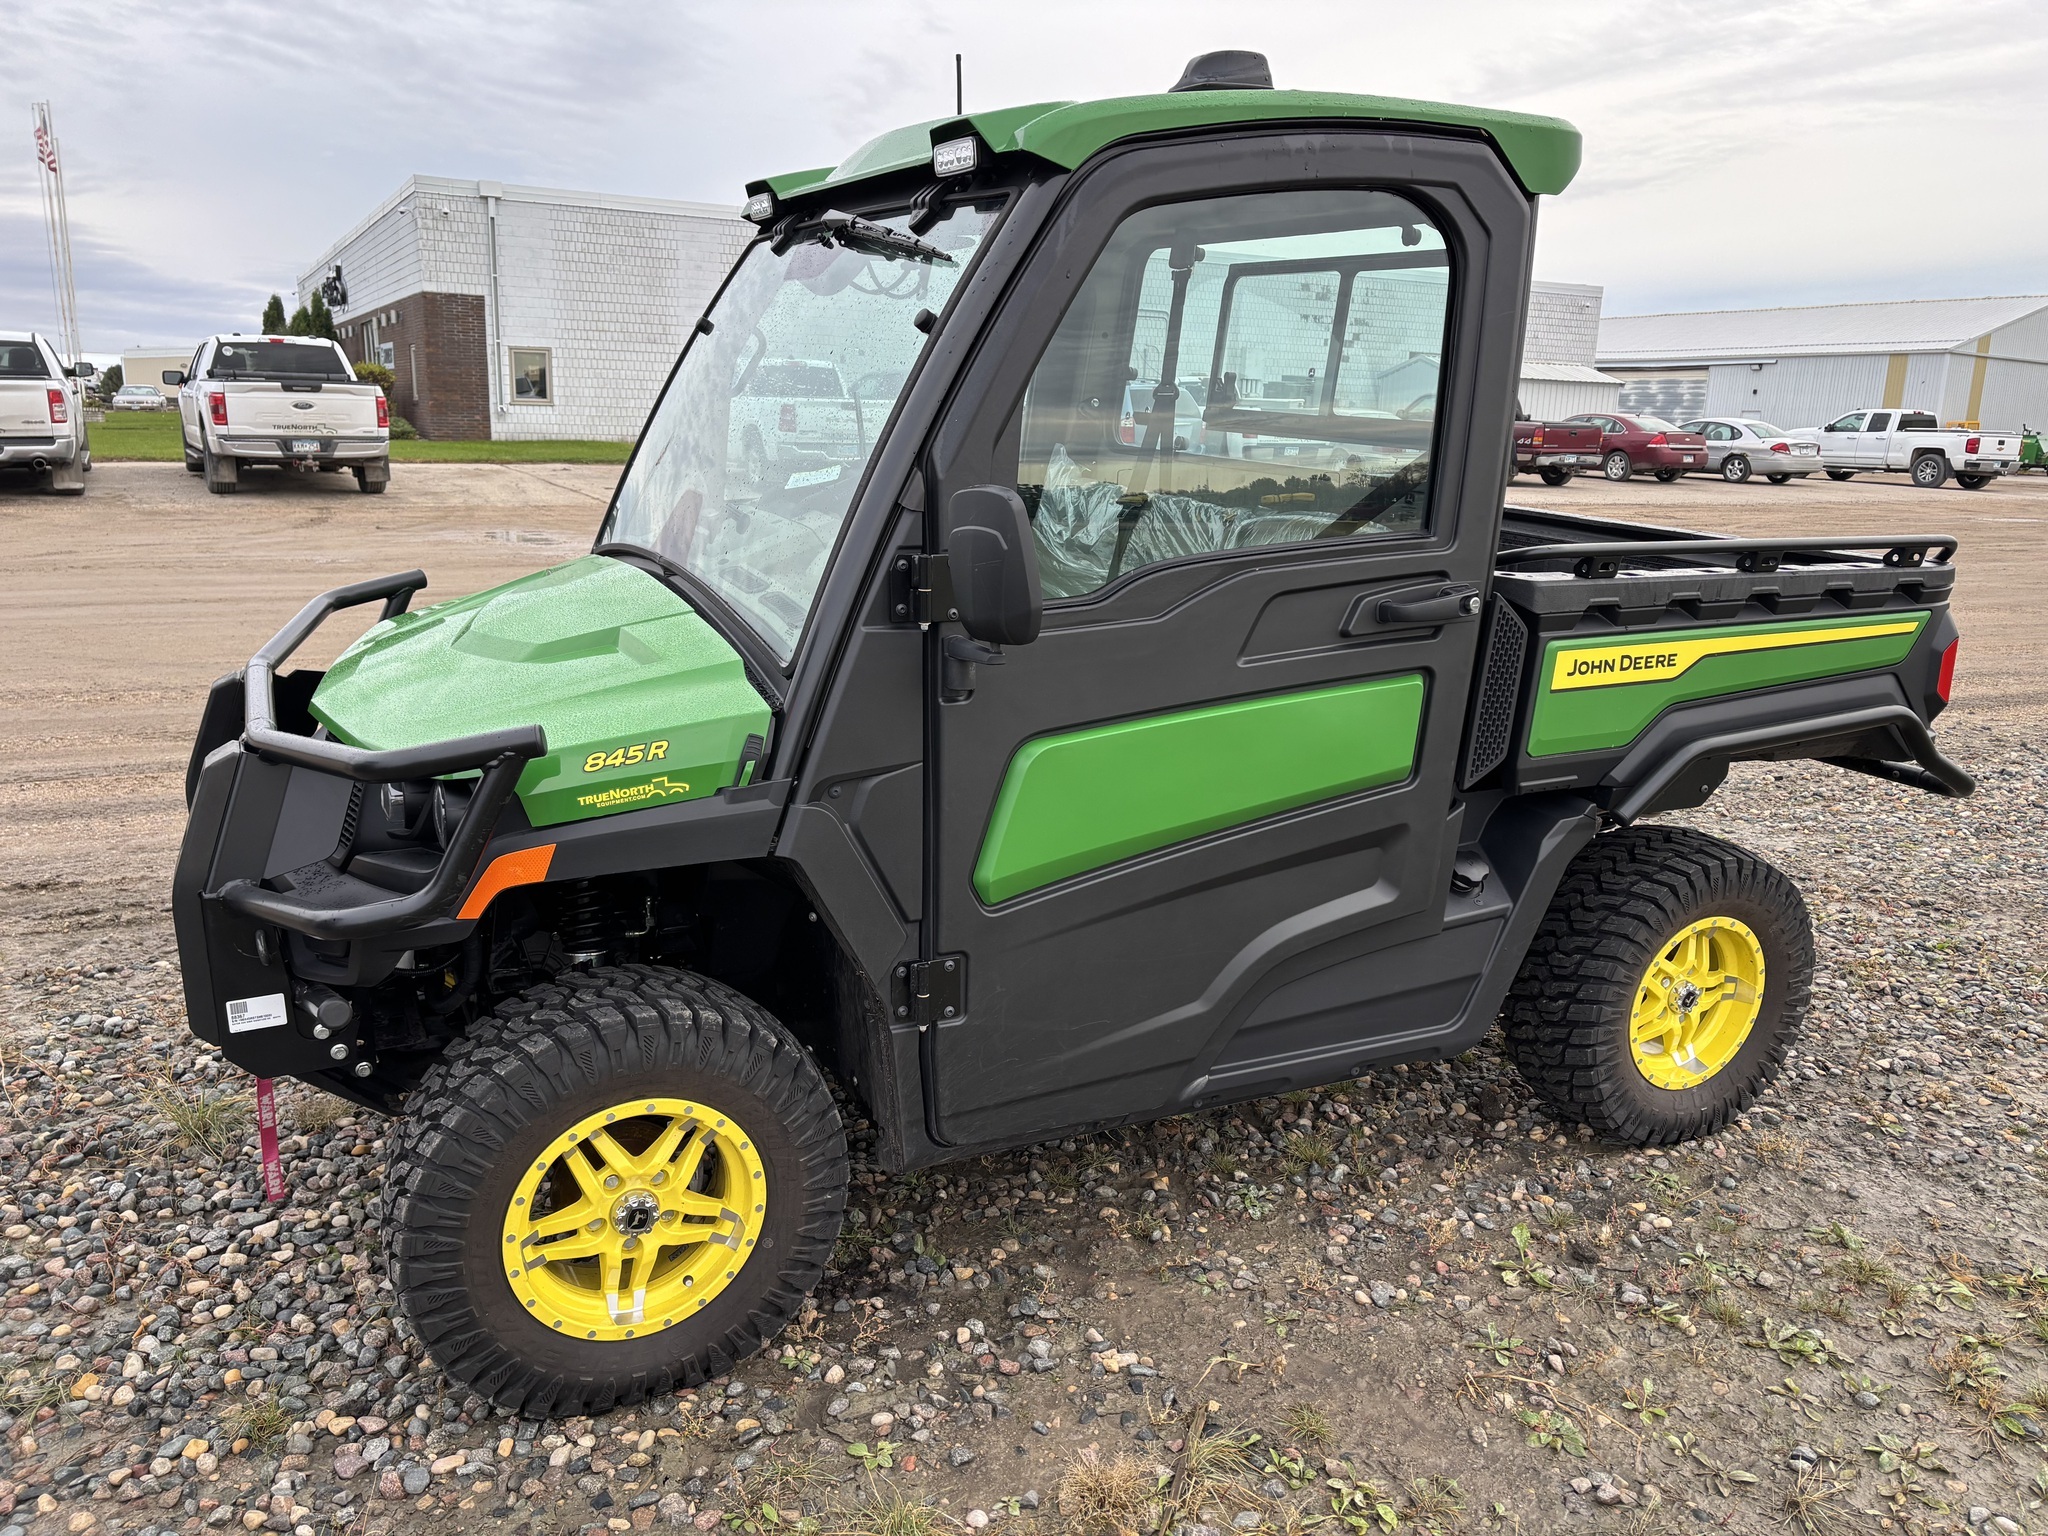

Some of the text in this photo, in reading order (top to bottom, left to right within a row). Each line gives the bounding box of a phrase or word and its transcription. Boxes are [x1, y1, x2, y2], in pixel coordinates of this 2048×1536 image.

[1567, 653, 1678, 676] JOHN DEERE
[582, 740, 670, 773] 845R
[577, 783, 655, 806] TRUENORTH
[596, 794, 647, 808] EQUIPMENT.COM
[259, 1092, 275, 1129] WARN
[265, 1159, 282, 1196] WARN
